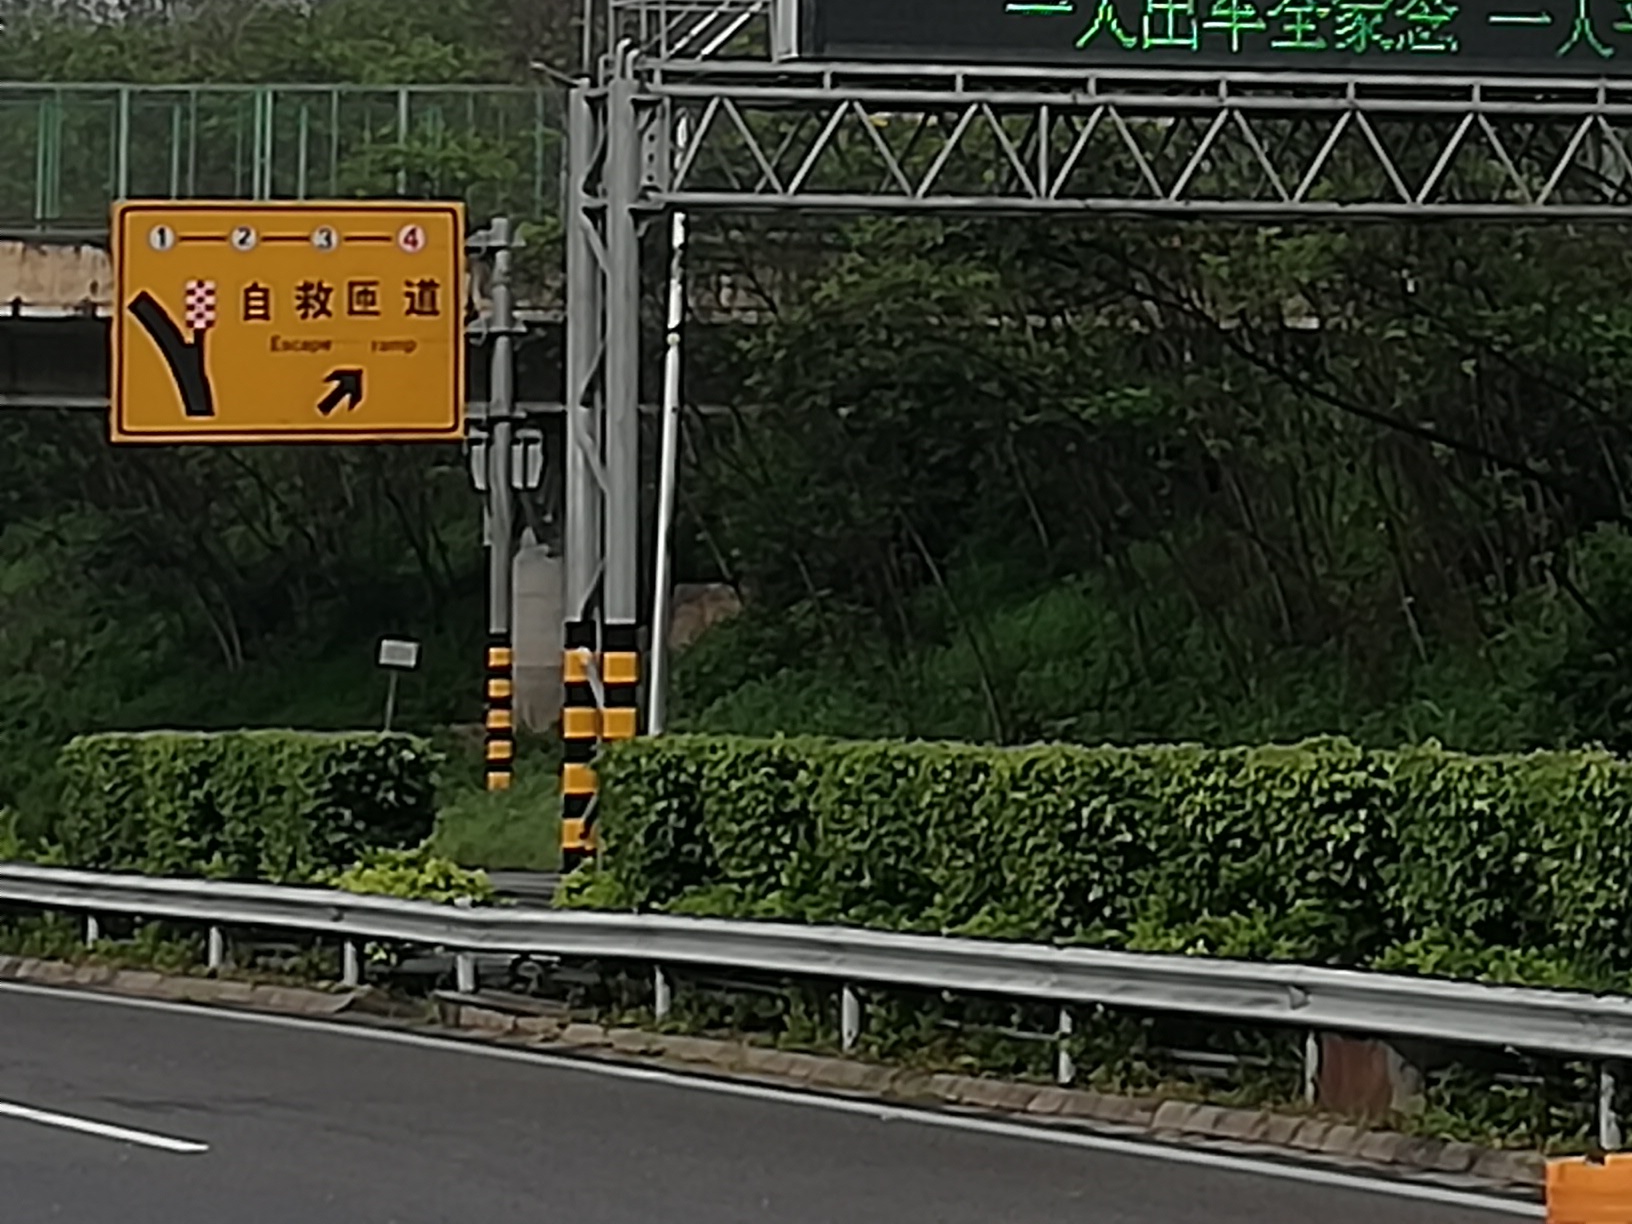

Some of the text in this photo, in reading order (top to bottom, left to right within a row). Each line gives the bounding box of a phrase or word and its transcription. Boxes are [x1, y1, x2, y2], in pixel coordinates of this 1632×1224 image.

[243, 279, 440, 321] 自救匝道
[271, 335, 416, 353] Escape ramp
